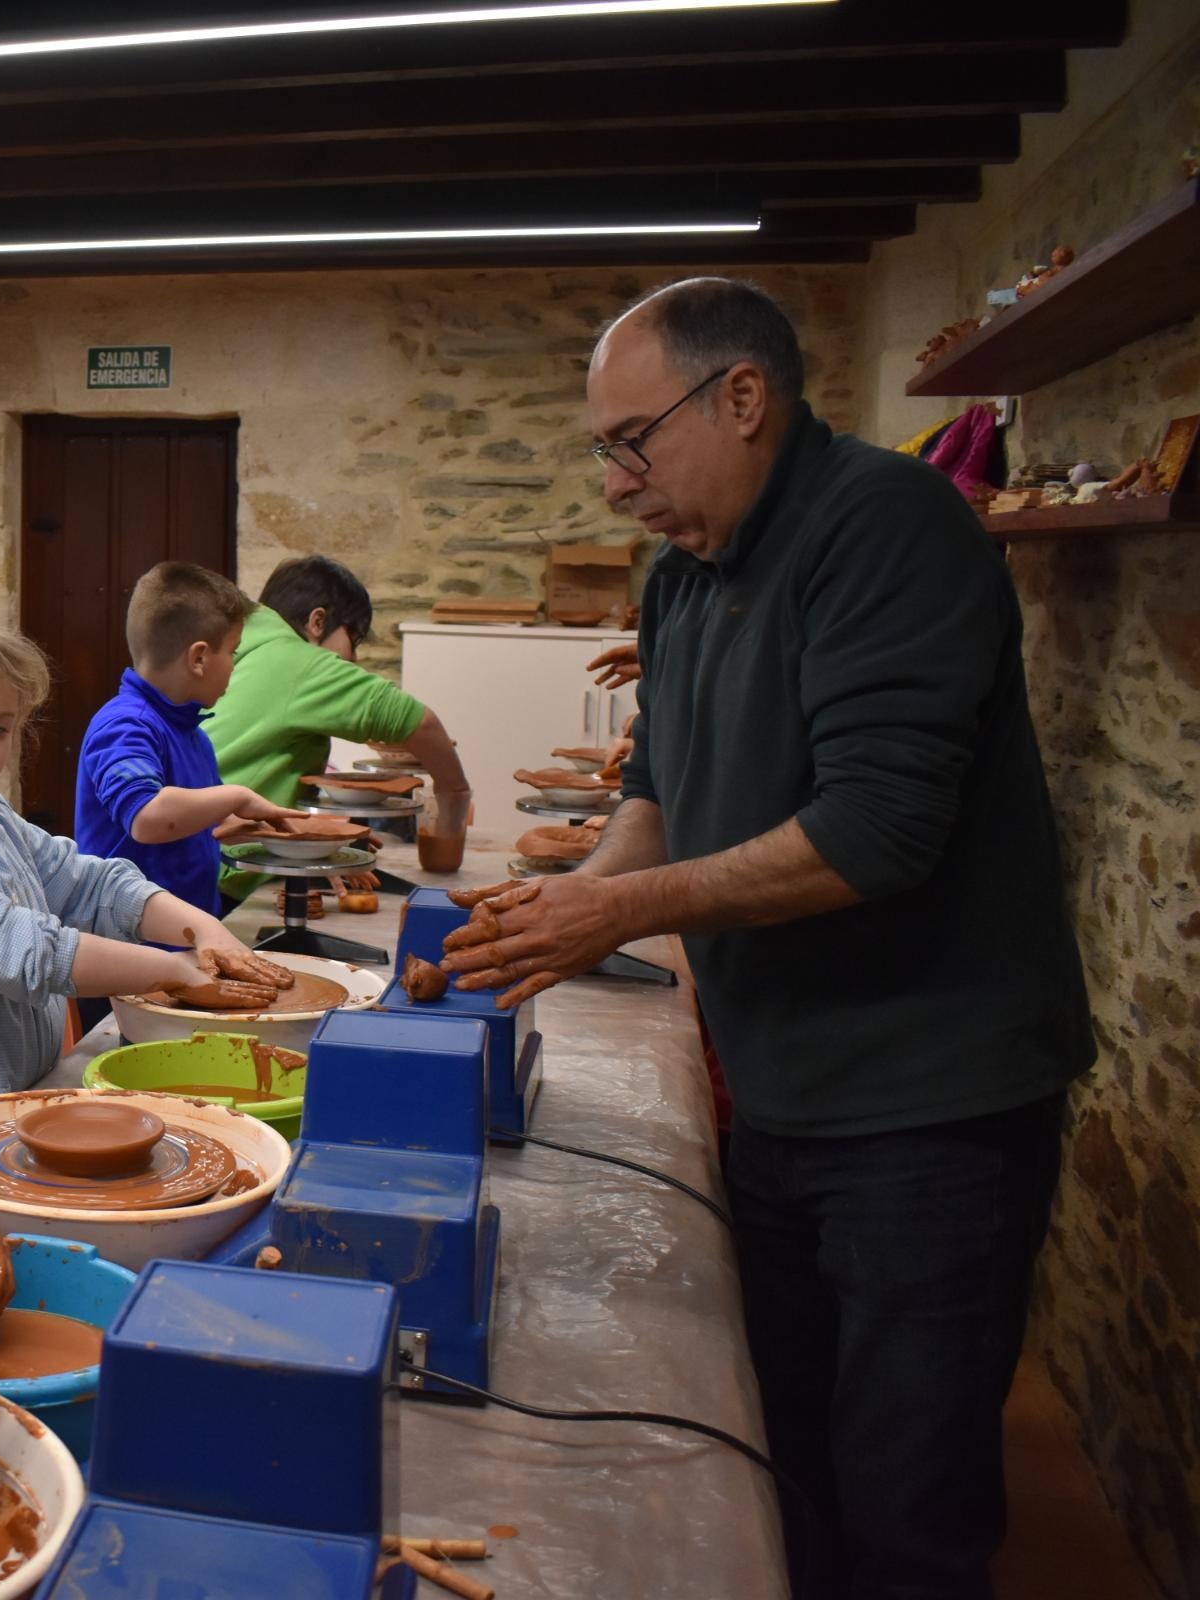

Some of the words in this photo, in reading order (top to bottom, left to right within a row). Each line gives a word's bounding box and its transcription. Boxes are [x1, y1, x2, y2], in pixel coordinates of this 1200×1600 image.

[98, 351, 140, 368] SALIDA
[143, 351, 160, 367] DE
[90, 368, 167, 385] EMERGENCIA
